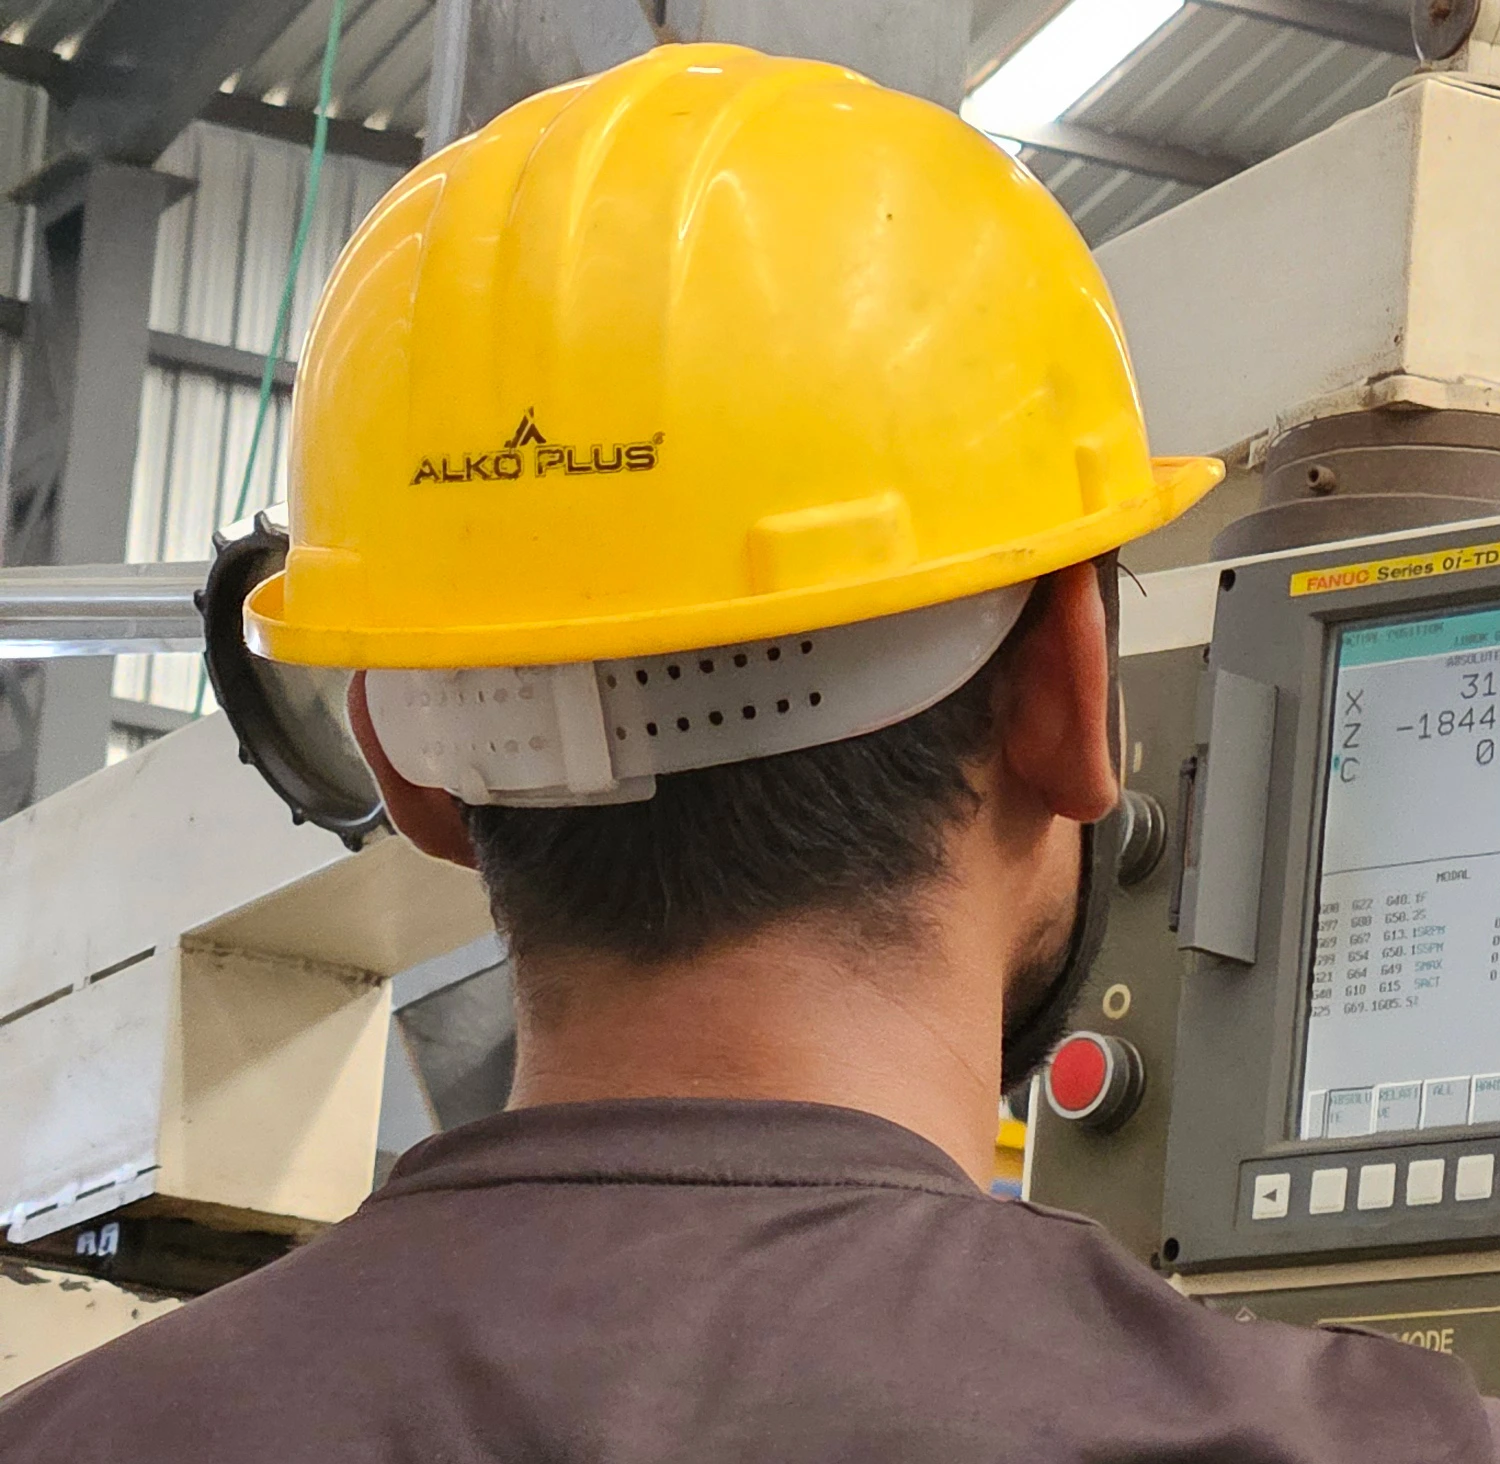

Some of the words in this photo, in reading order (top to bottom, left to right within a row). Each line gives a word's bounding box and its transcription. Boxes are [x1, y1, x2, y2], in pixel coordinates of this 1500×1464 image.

[409, 450, 524, 485] ALKO
[535, 441, 658, 477] PLUS
[1307, 569, 1369, 591] FANUC
[1377, 561, 1434, 581] Series
[1345, 689, 1365, 716] X
[1343, 723, 1361, 749] Z
[1340, 757, 1361, 783] C
[1436, 869, 1470, 883] MODAL
[1400, 1328, 1455, 1356] ODE
